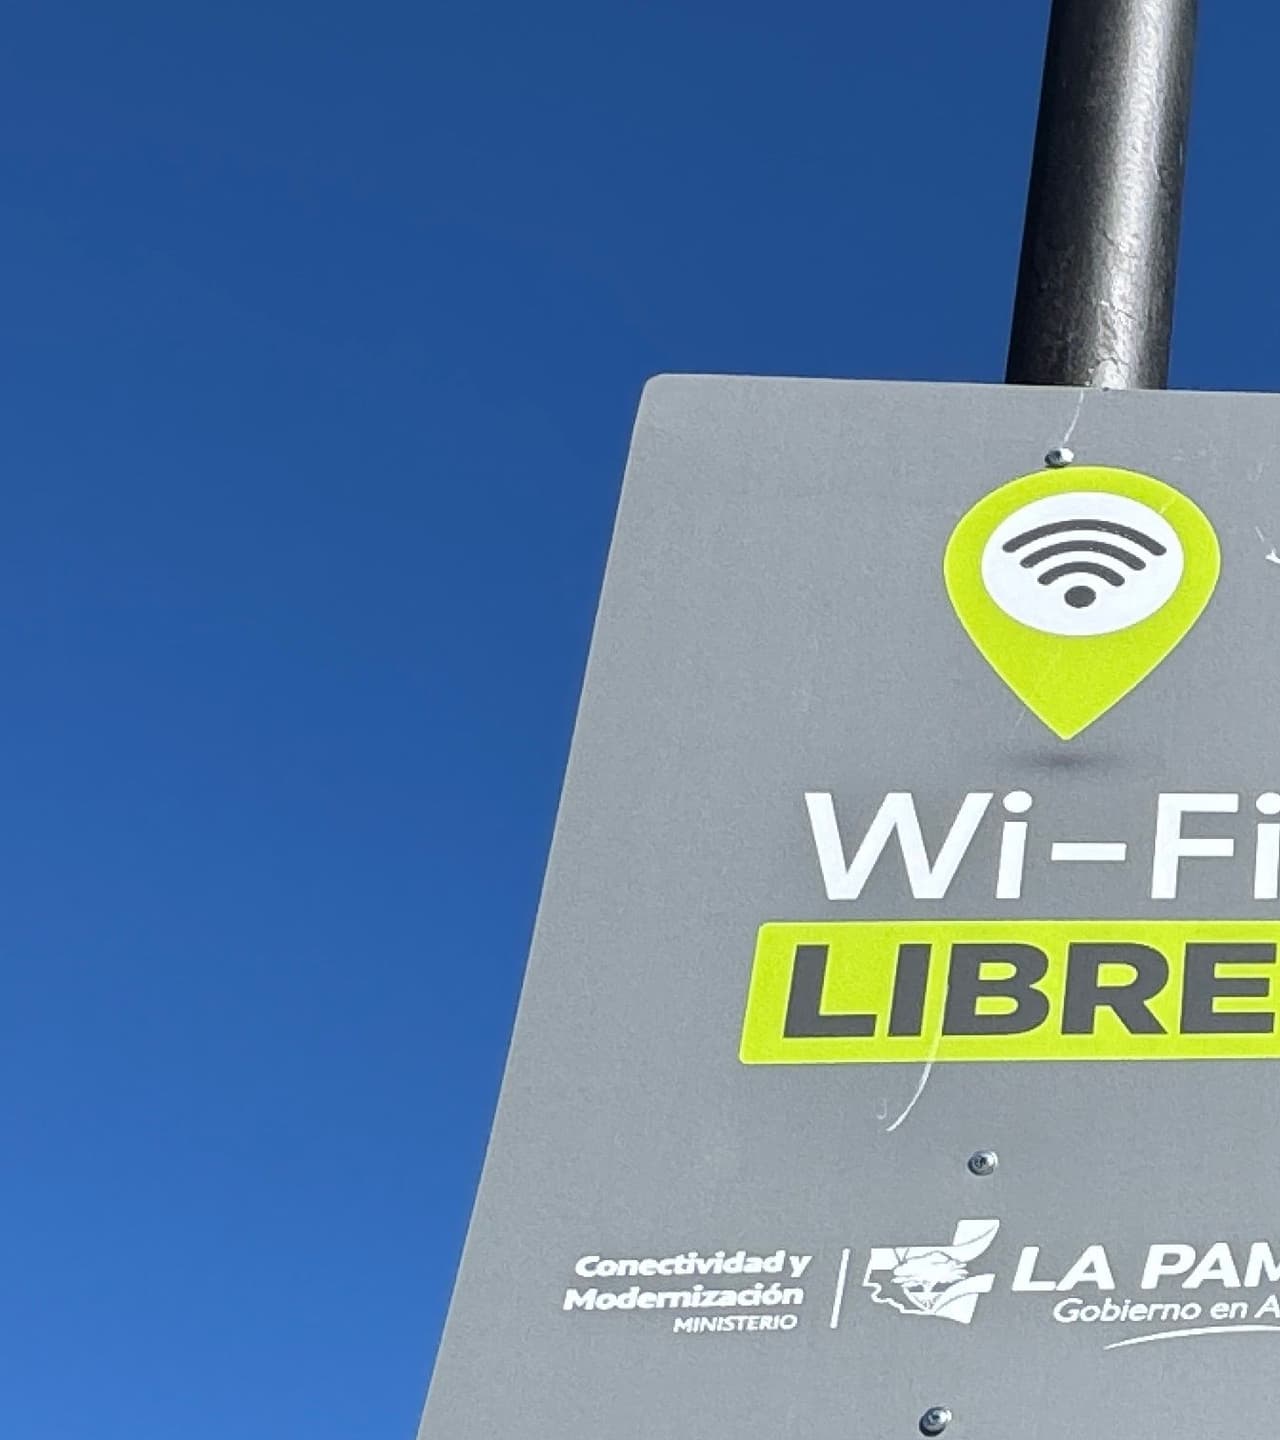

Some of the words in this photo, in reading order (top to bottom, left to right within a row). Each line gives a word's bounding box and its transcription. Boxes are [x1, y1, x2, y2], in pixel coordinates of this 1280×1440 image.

[782, 942, 1278, 1039] LIBRE
[574, 1249, 786, 1278] Conectividad
[789, 1255, 813, 1278] y
[1011, 1244, 1117, 1292] LA
[562, 1282, 804, 1311] Modernización
[1052, 1297, 1202, 1324] Gobierno
[1209, 1301, 1249, 1320] en
[672, 1314, 798, 1333] MINISTERIO
